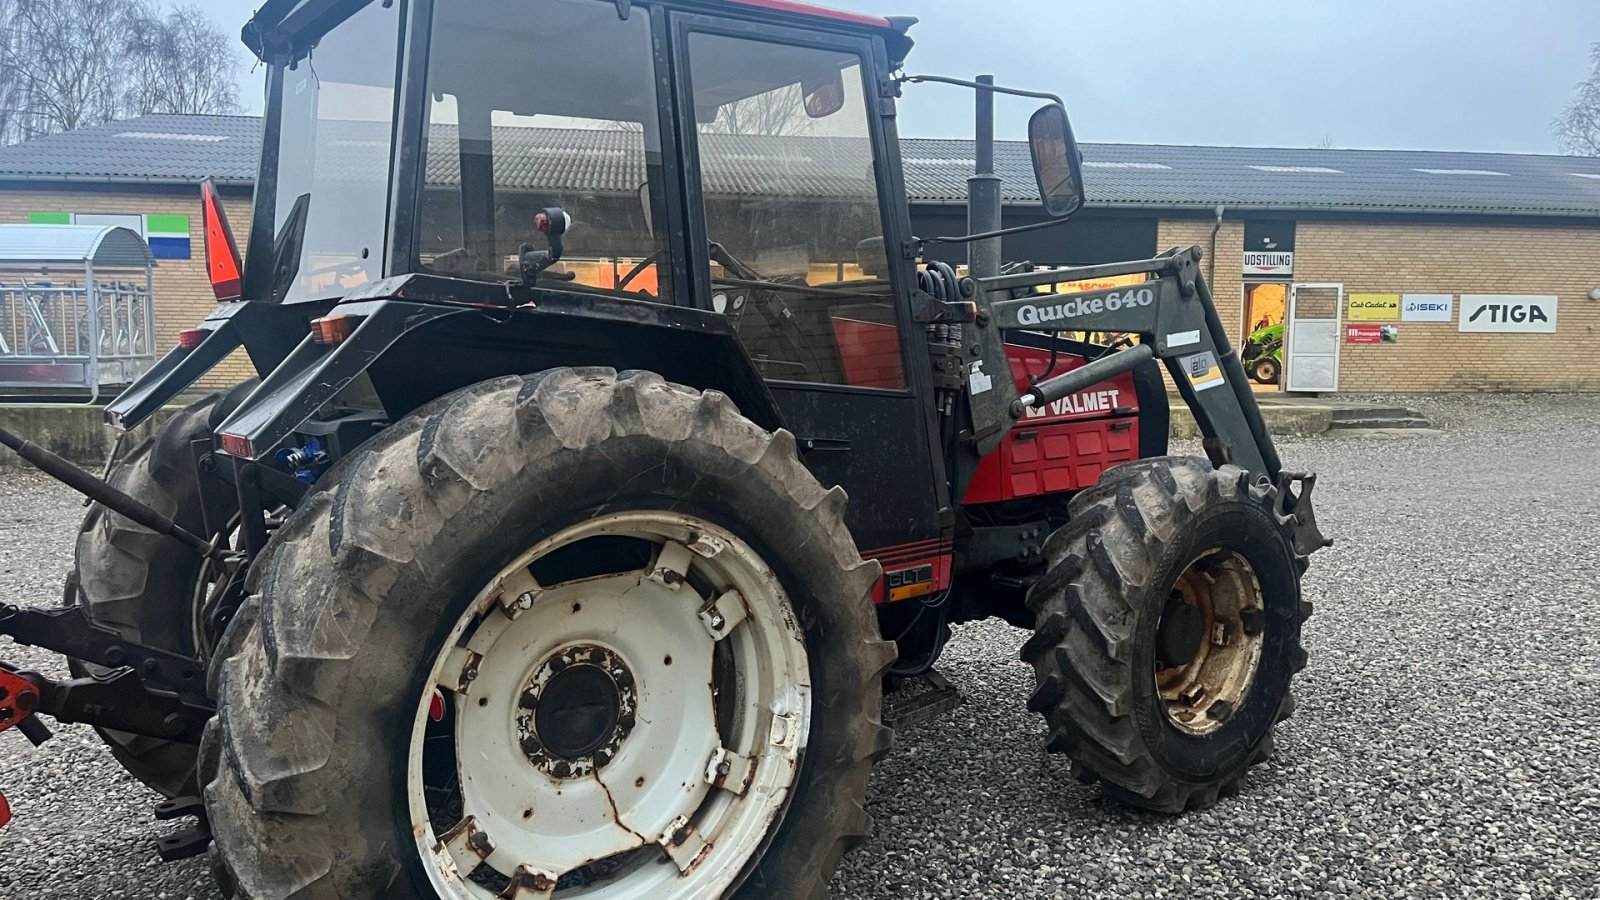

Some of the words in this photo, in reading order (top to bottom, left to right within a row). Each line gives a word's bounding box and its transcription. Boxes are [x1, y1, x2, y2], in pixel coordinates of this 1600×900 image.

[1244, 254, 1290, 266] UDSTILLING
[1017, 297, 1104, 326] Quicke
[1105, 288, 1154, 311] 640
[1416, 303, 1448, 311] ISEKI
[1468, 304, 1548, 323] STIGA
[1050, 389, 1119, 416] VALMET
[889, 568, 922, 587] GLT
